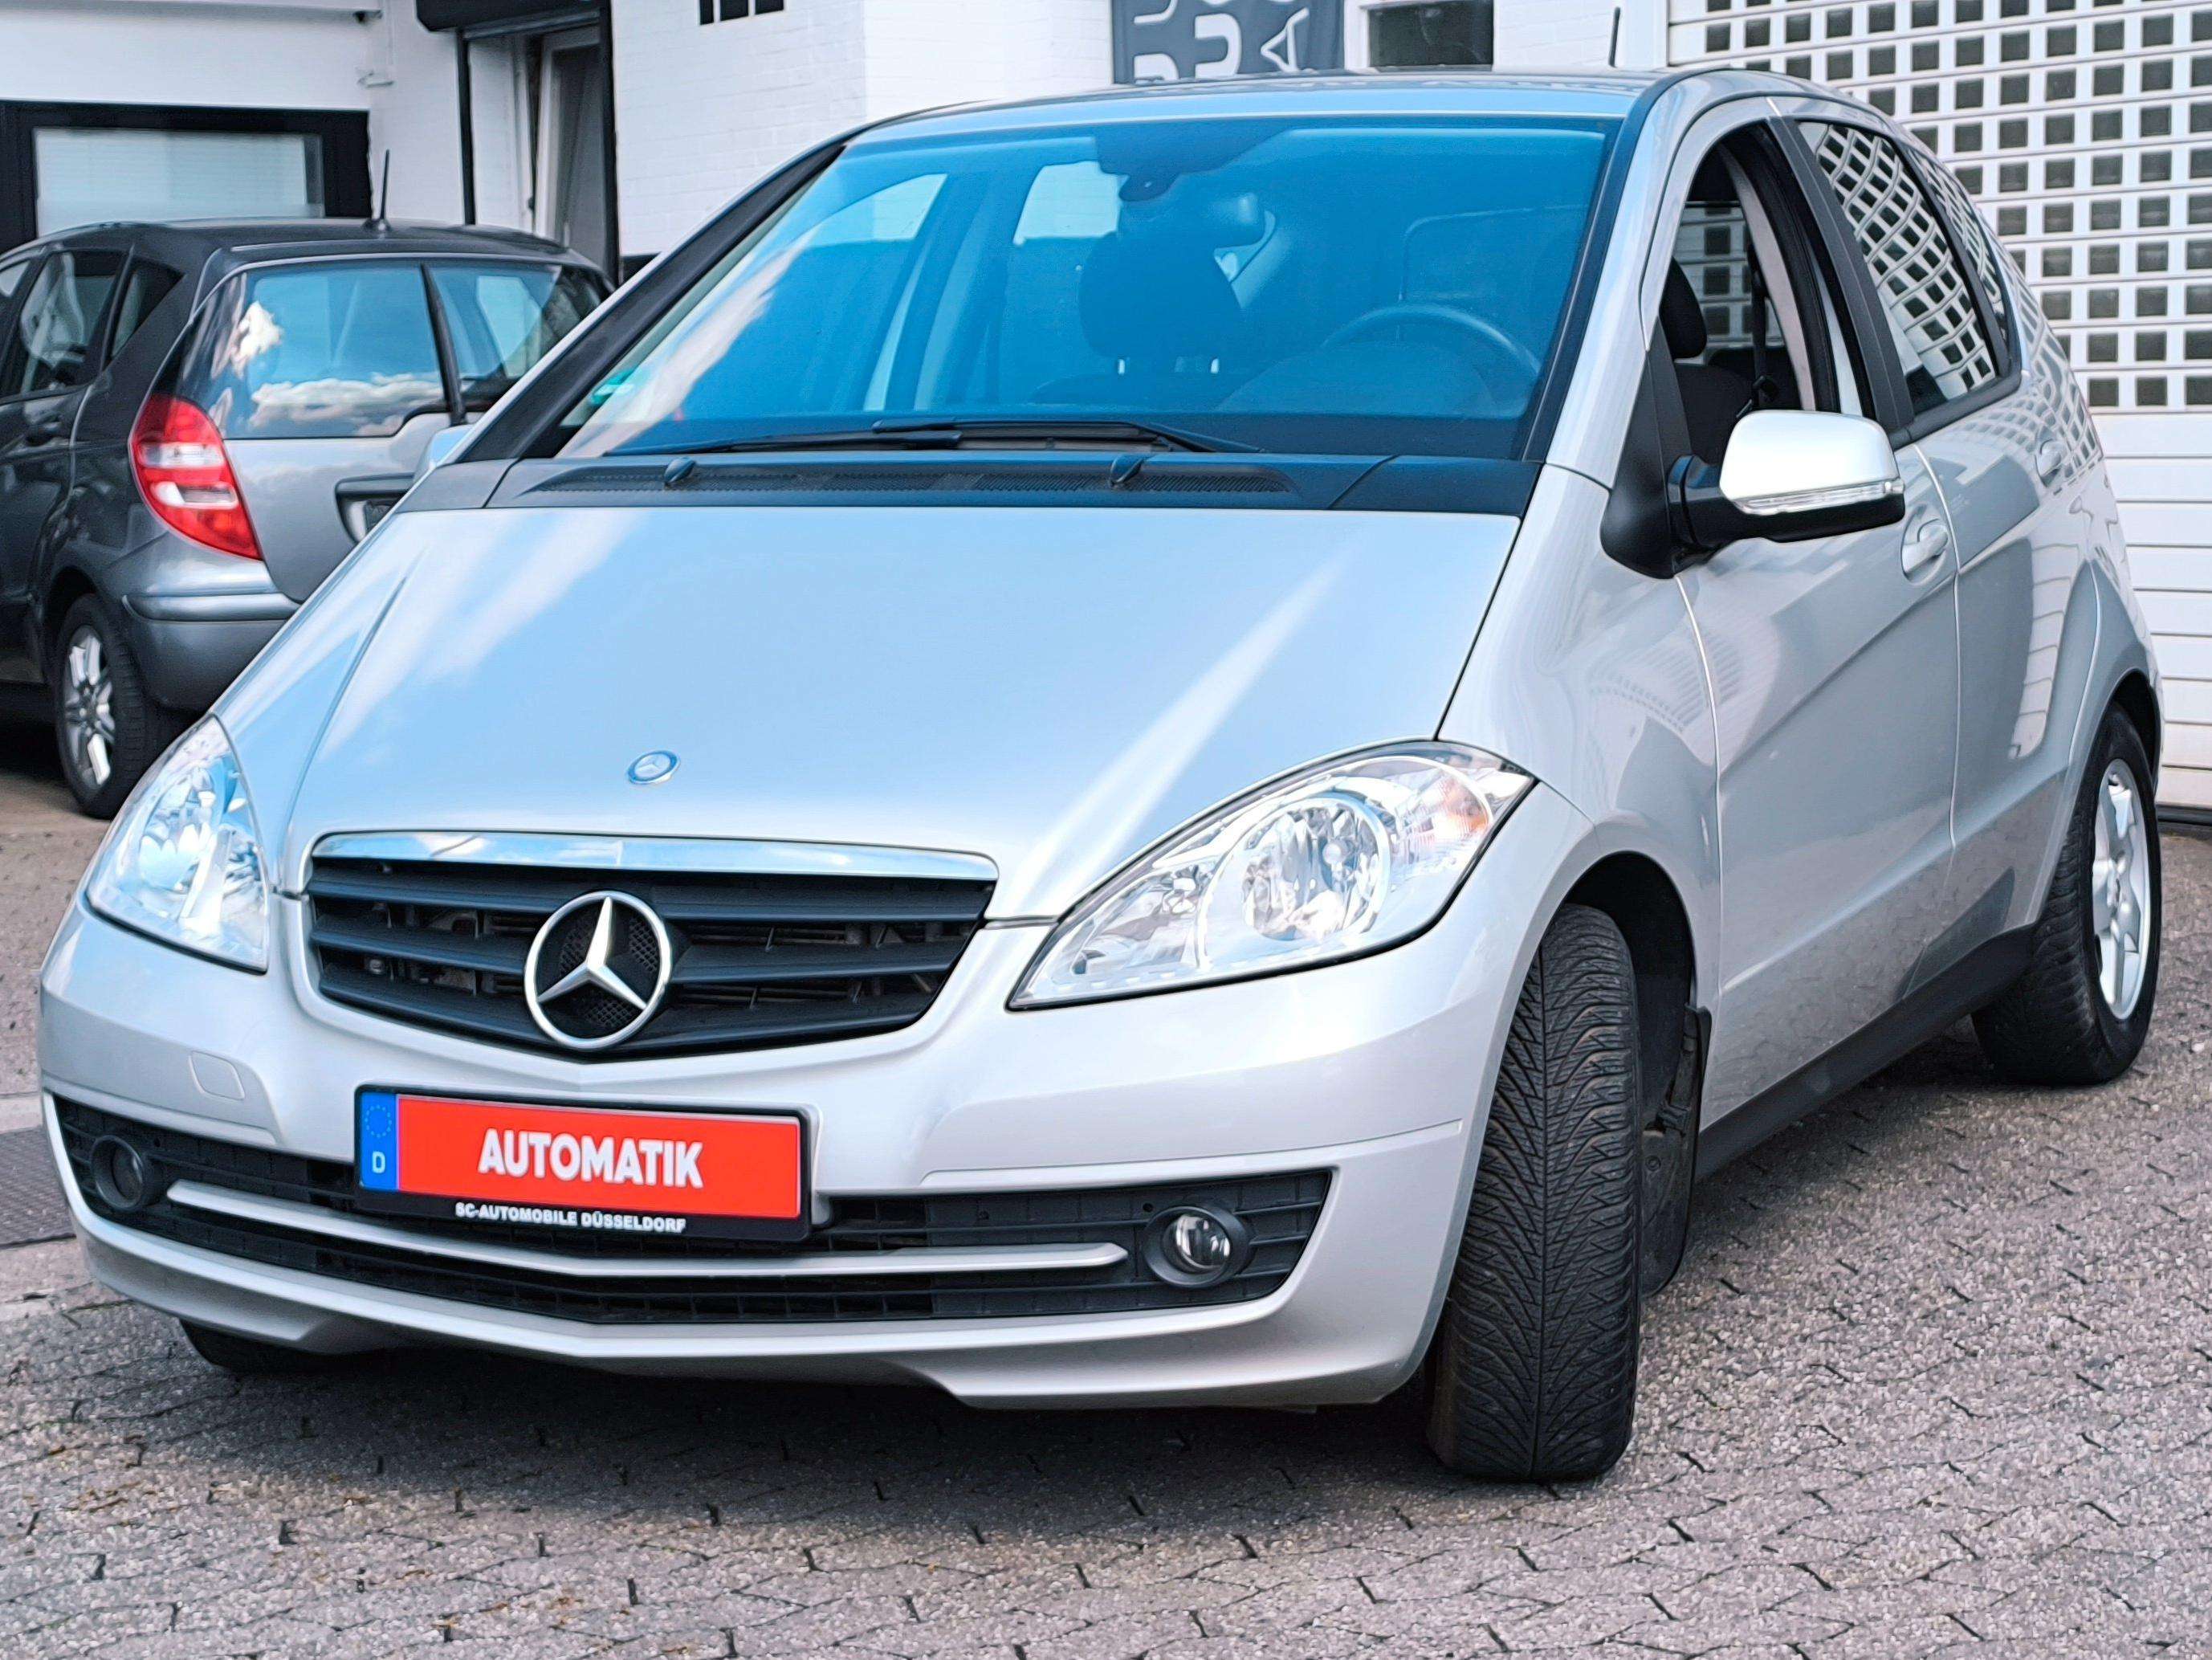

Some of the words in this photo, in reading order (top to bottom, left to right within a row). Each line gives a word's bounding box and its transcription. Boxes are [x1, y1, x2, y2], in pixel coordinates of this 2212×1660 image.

[372, 1151, 386, 1173] D
[478, 1128, 703, 1189] AUTOMATIK
[580, 1211, 686, 1234] DÜSSELDORF
